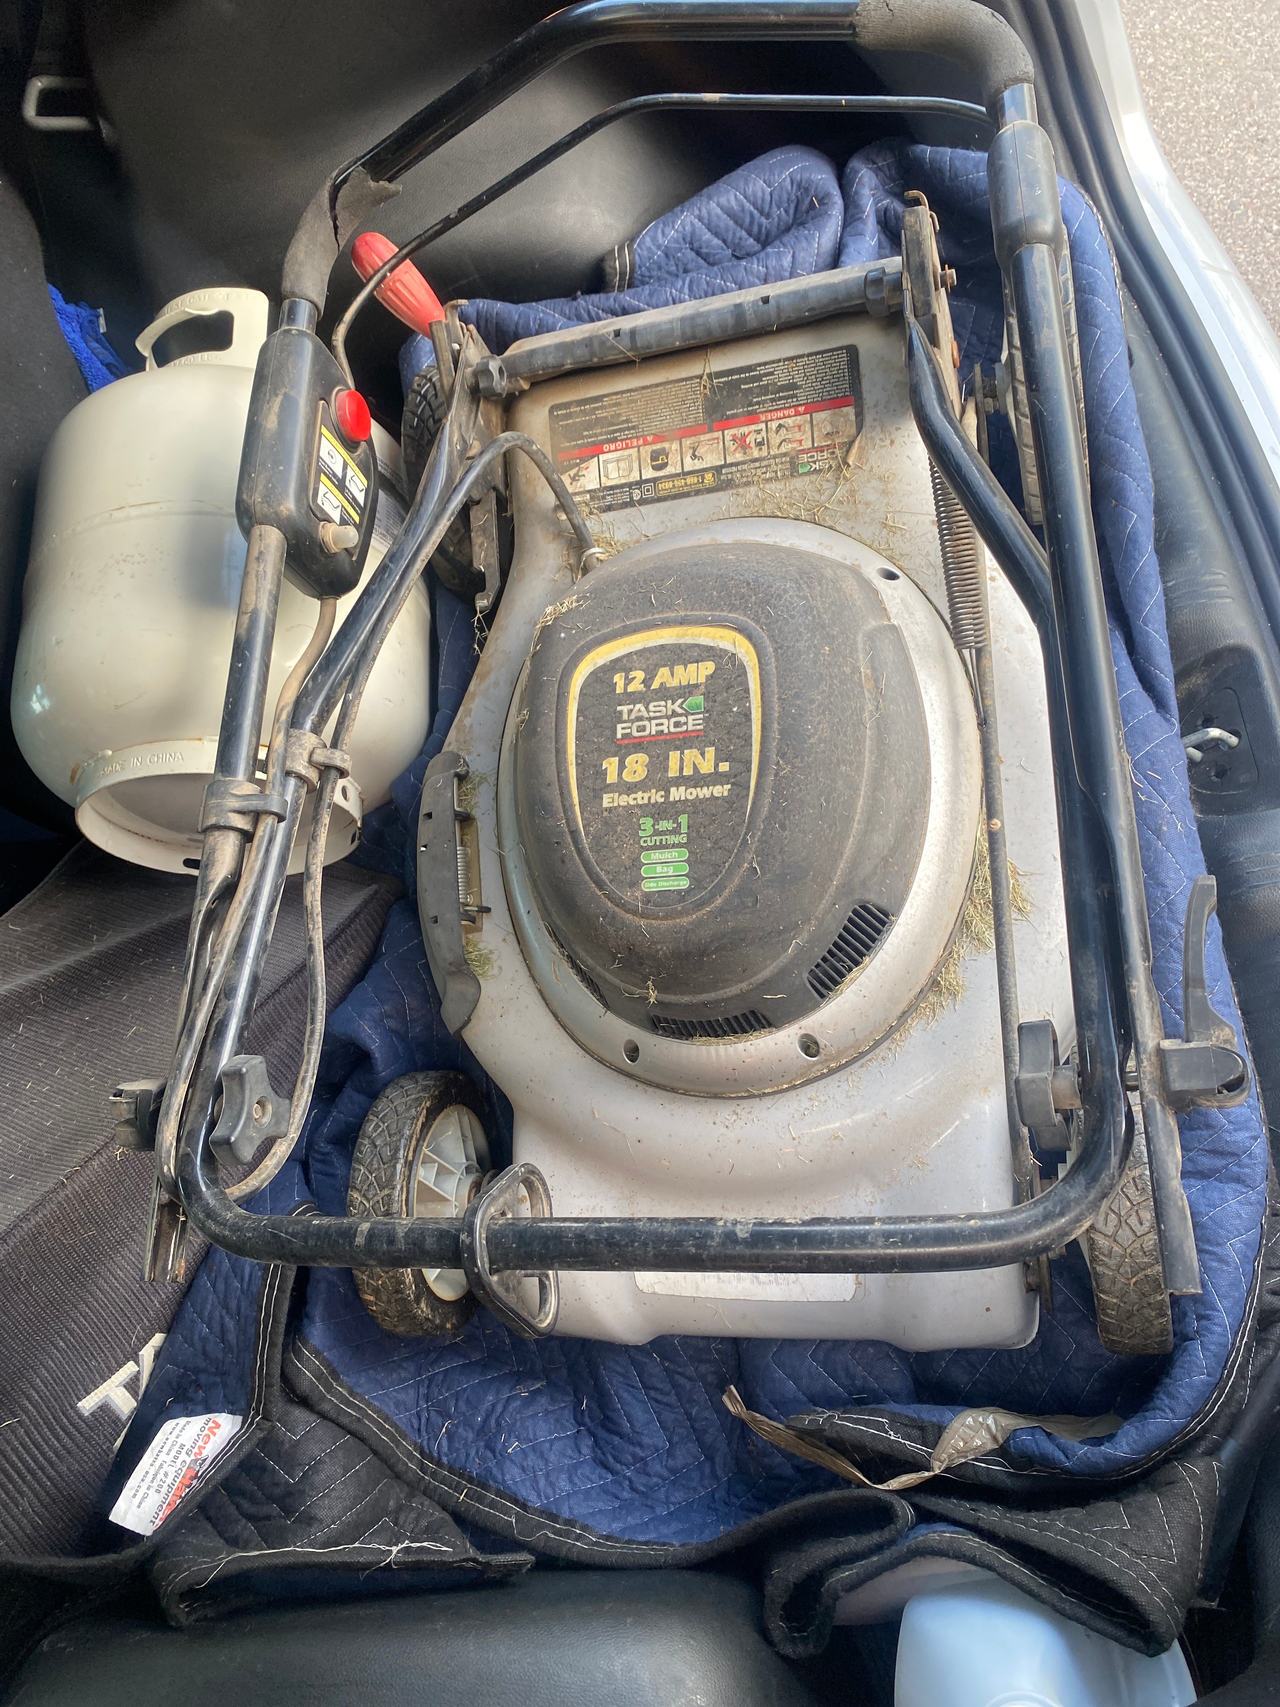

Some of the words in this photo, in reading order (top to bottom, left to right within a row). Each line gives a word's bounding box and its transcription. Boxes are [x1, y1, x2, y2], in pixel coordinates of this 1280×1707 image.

[759, 409, 796, 422] DANGER
[602, 438, 644, 452] PELIGRO
[613, 670, 646, 694] 12
[650, 661, 716, 690] AMP
[616, 698, 686, 721] TASK
[616, 713, 704, 739] FORCE
[101, 760, 125, 777] MADE
[130, 757, 143, 768] IN
[147, 752, 184, 766] CHINA
[602, 752, 649, 784] 18
[668, 746, 730, 777] IN.
[602, 788, 665, 808] Electric
[669, 784, 732, 801] Mower
[640, 834, 688, 847] CUTTING
[650, 851, 679, 861] Mulch
[656, 866, 674, 875] Bag
[185, 1416, 212, 1458] moving
[193, 1419, 222, 1460] New
[167, 1443, 187, 1469] MODEL
[150, 1460, 188, 1527] equipment
